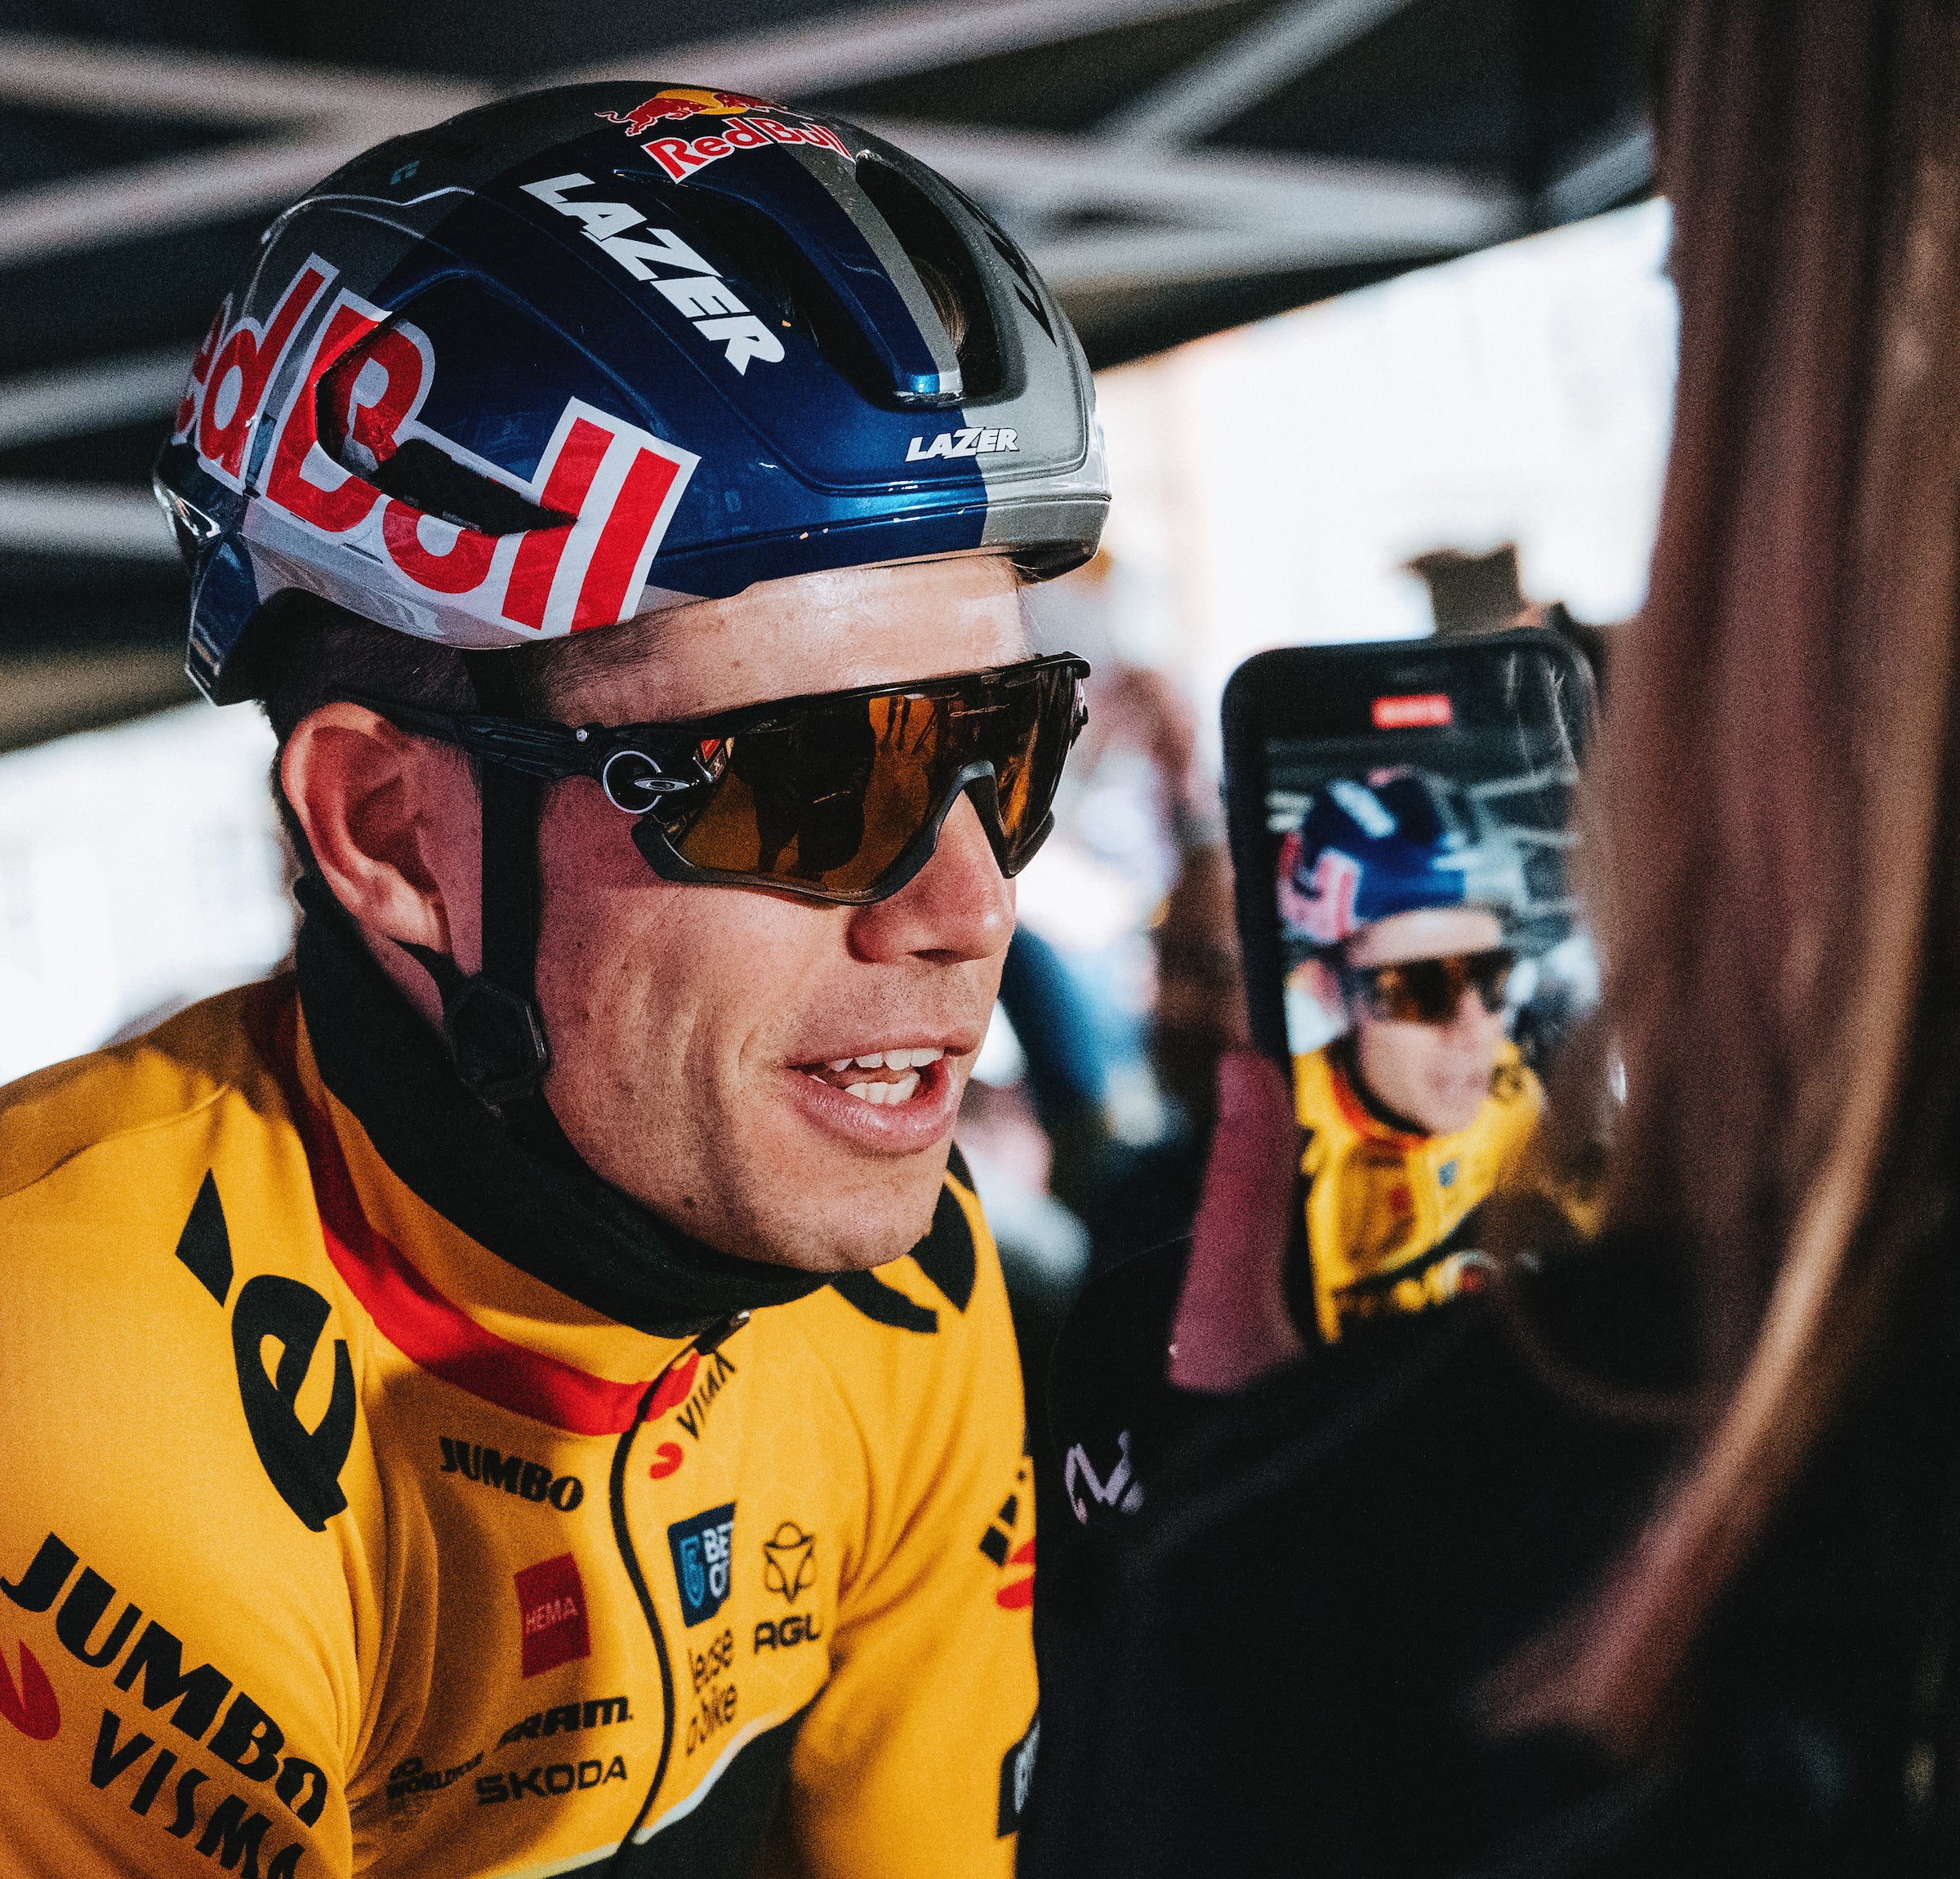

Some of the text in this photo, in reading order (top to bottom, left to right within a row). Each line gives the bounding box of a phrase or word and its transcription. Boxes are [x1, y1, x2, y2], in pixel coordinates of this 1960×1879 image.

[641, 116, 856, 185] Red Bull
[519, 171, 786, 376] LAZER
[904, 426, 1020, 463] LAZER
[439, 1435, 585, 1513] JUMBO
[524, 1595, 581, 1636] HEMA
[0, 1531, 328, 1828] JUMBO
[475, 1755, 629, 1807] SKODA
